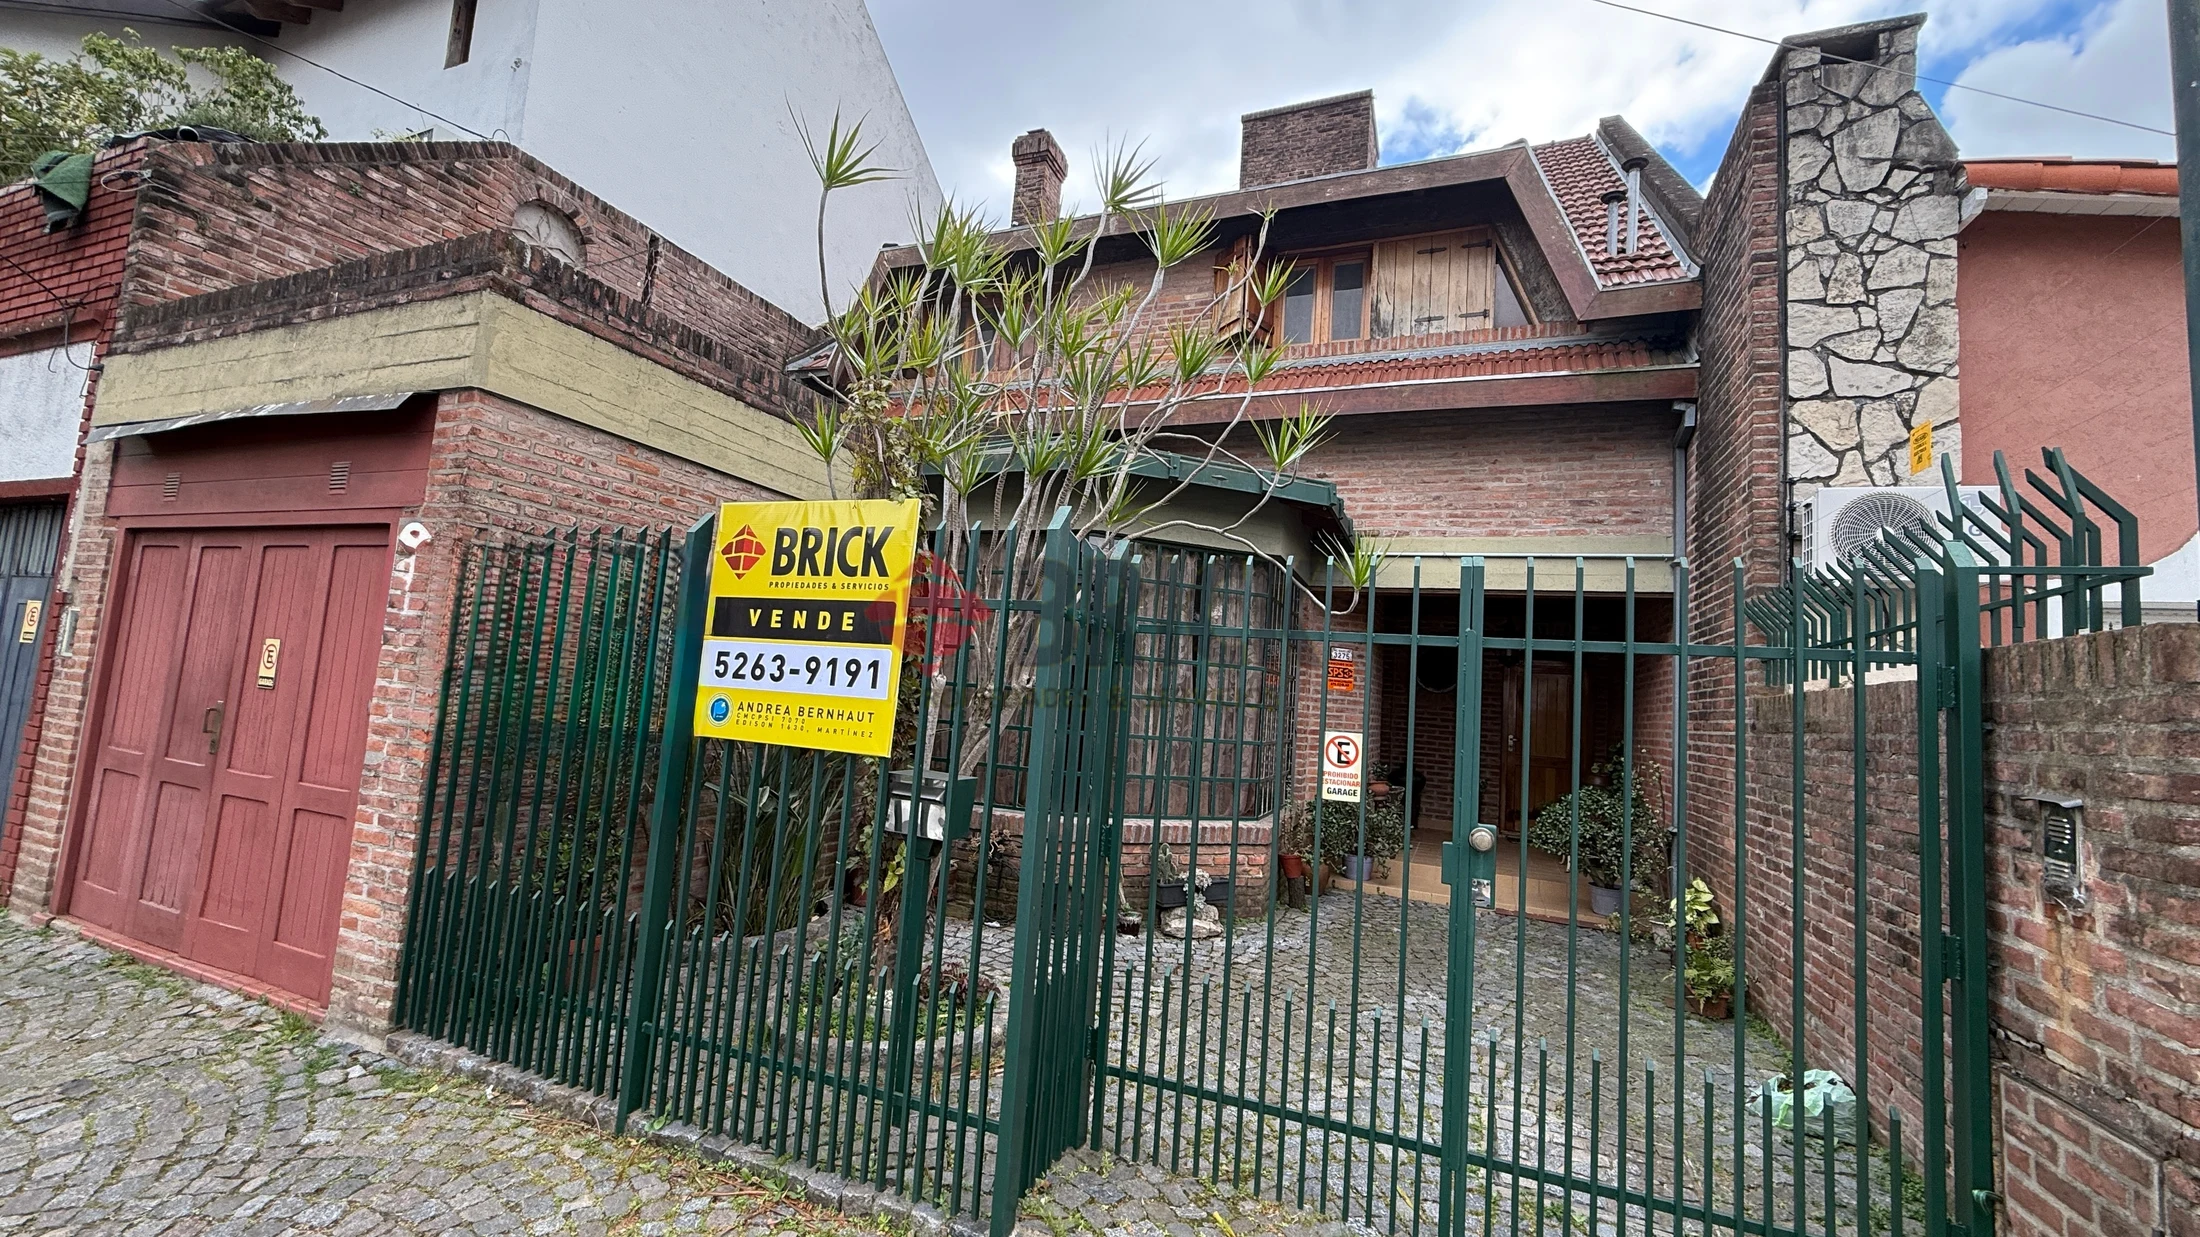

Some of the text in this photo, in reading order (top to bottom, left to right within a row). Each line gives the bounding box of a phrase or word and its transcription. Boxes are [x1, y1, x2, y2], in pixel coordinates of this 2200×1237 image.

[771, 525, 895, 578] BRICK
[768, 581, 890, 591] PROPIEDADES & SERVICIOS
[749, 608, 855, 631] VENDE
[714, 650, 881, 690] 5263-9191
[1328, 667, 1345, 678] SPS
[737, 701, 875, 724] ANDREA BERNHAUT
[781, 716, 806, 725] 7070
[735, 718, 774, 729] EDISON
[816, 726, 874, 739] MARTÍNEZ
[1323, 770, 1359, 780] PROHIBIDO
[1326, 786, 1359, 797] GARAGE
